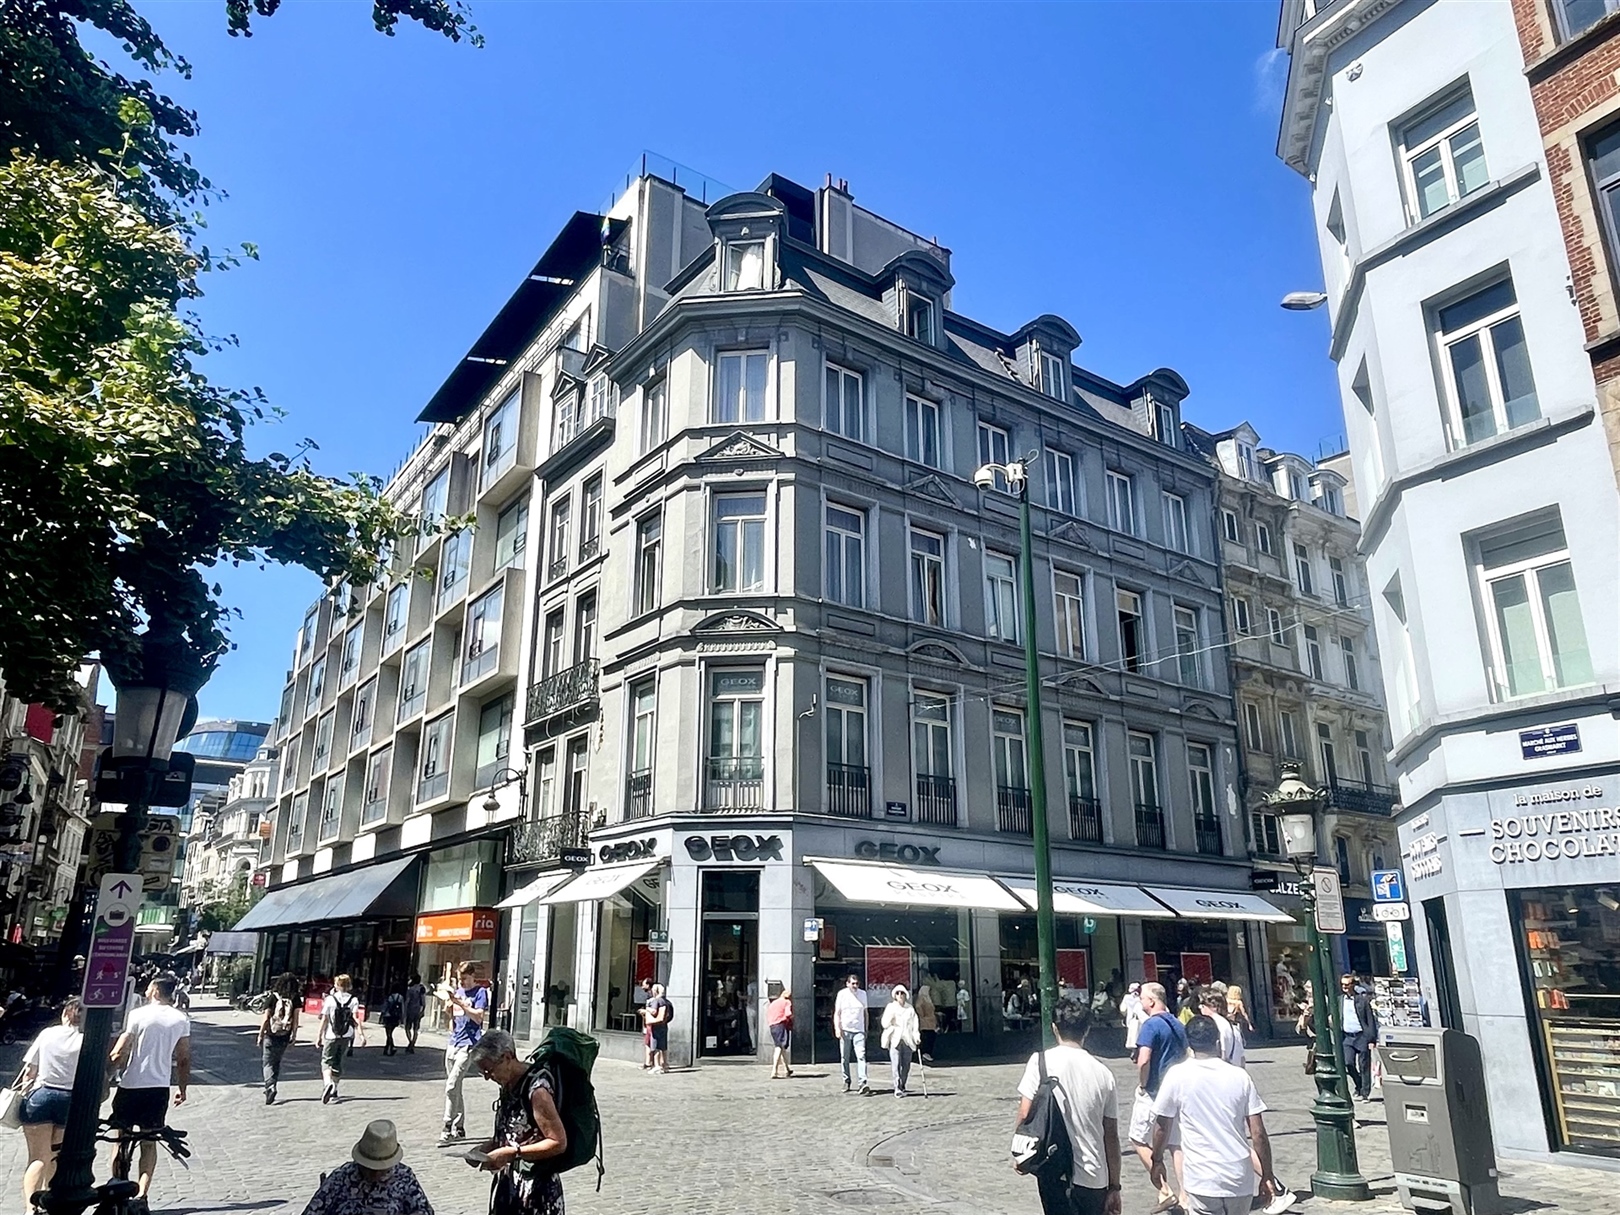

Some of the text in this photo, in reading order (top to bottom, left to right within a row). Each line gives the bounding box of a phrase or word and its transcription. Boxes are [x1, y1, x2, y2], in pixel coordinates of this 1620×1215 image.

[720, 677, 757, 685] GEOX
[830, 684, 858, 696] GEOX
[1513, 784, 1602, 807] la maison de
[684, 834, 784, 861] GEOX
[854, 840, 942, 865] GEOX
[564, 854, 589, 862] GEOX
[886, 880, 960, 893] GEOX
[1054, 886, 1105, 896] GEOX
[1195, 899, 1247, 909] GEOX
